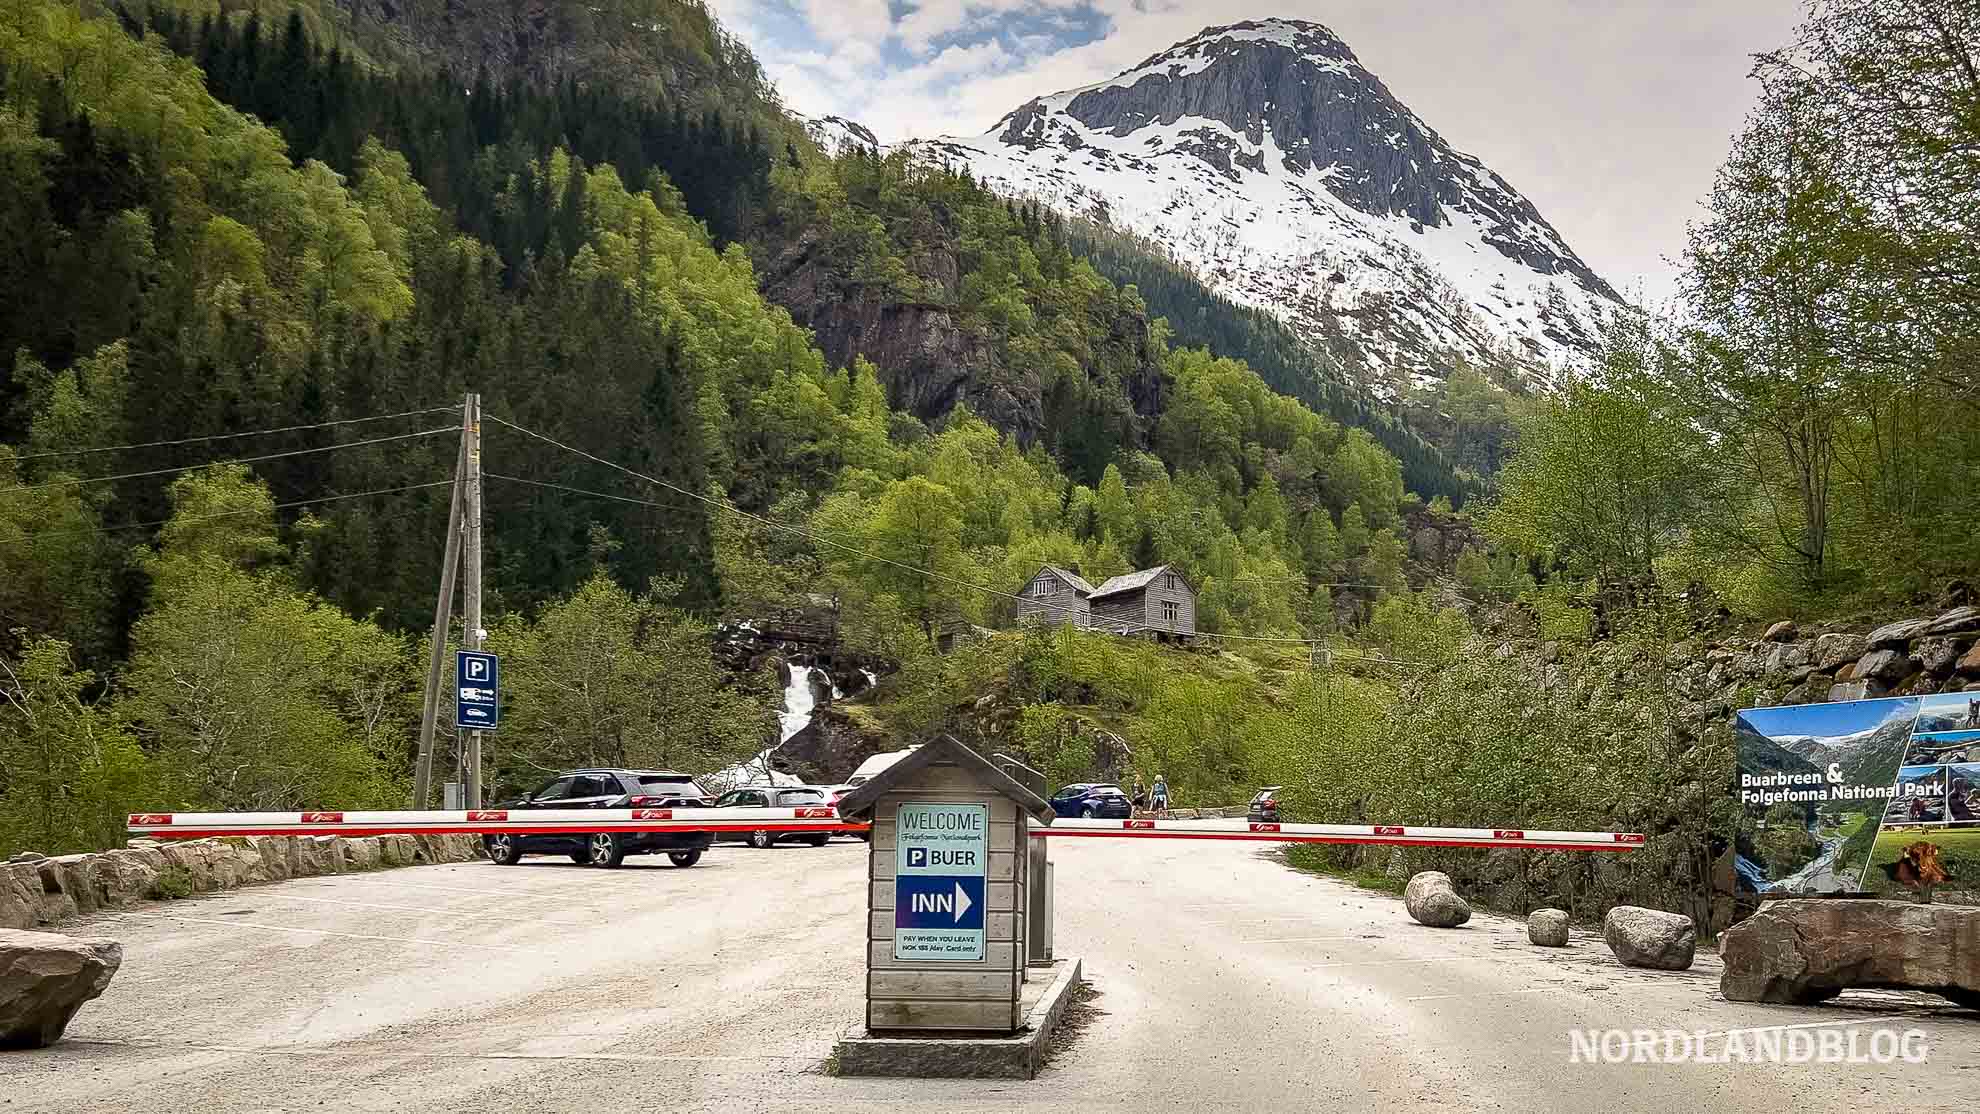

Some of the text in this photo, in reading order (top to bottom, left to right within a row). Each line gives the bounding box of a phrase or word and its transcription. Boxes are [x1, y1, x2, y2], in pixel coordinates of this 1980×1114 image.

[471, 661, 484, 677] P
[1741, 762, 1844, 788] Buarbreen &
[1741, 781, 1945, 806] Folgefonna National Park
[903, 812, 982, 830] WELCOME
[911, 850, 976, 866] P BUER
[911, 893, 953, 913] INN
